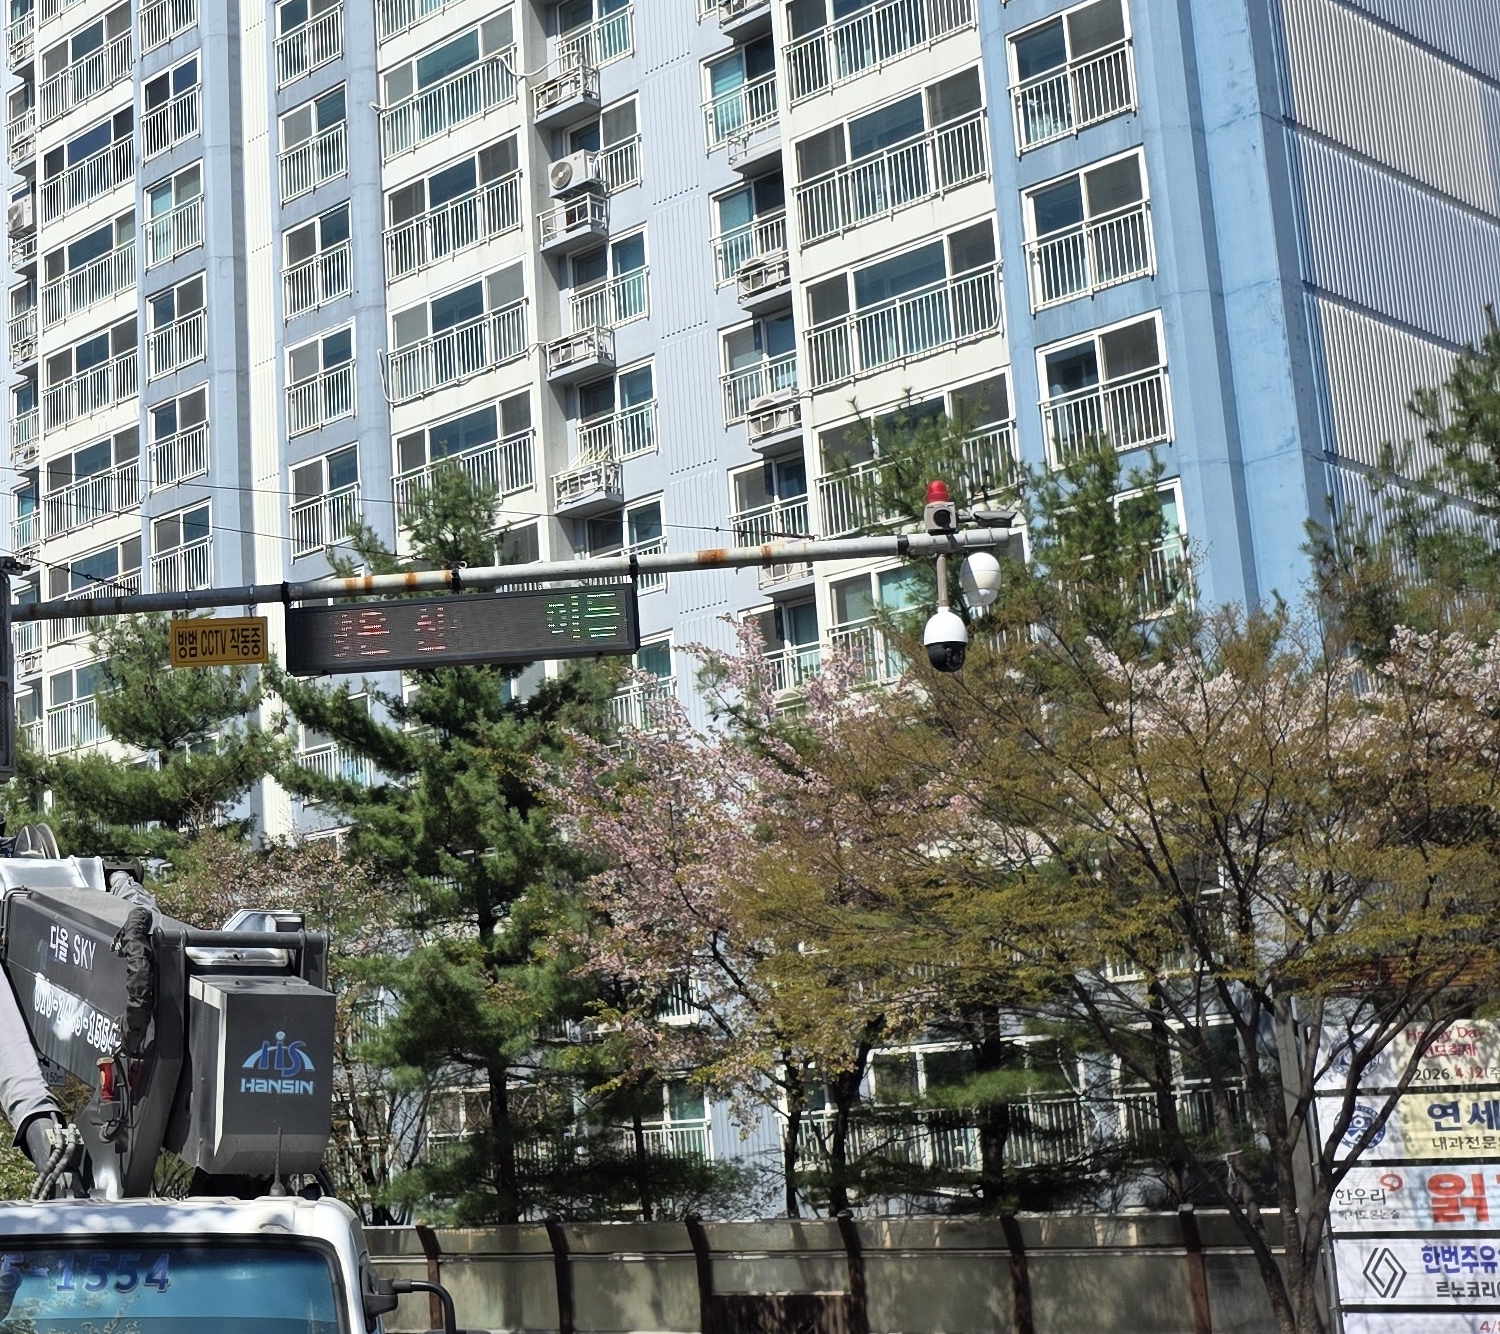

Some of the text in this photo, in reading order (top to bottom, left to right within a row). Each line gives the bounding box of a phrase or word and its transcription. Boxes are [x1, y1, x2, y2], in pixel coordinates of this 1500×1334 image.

[178, 627, 261, 659] 방범 CCTV 작동중
[50, 924, 97, 971] 다올 SKY
[1431, 1136, 1500, 1150] 내과전문
[1335, 1188, 1387, 1206] 한우리
[1427, 1173, 1500, 1223] 읽
[1421, 1245, 1500, 1274] 한번주유
